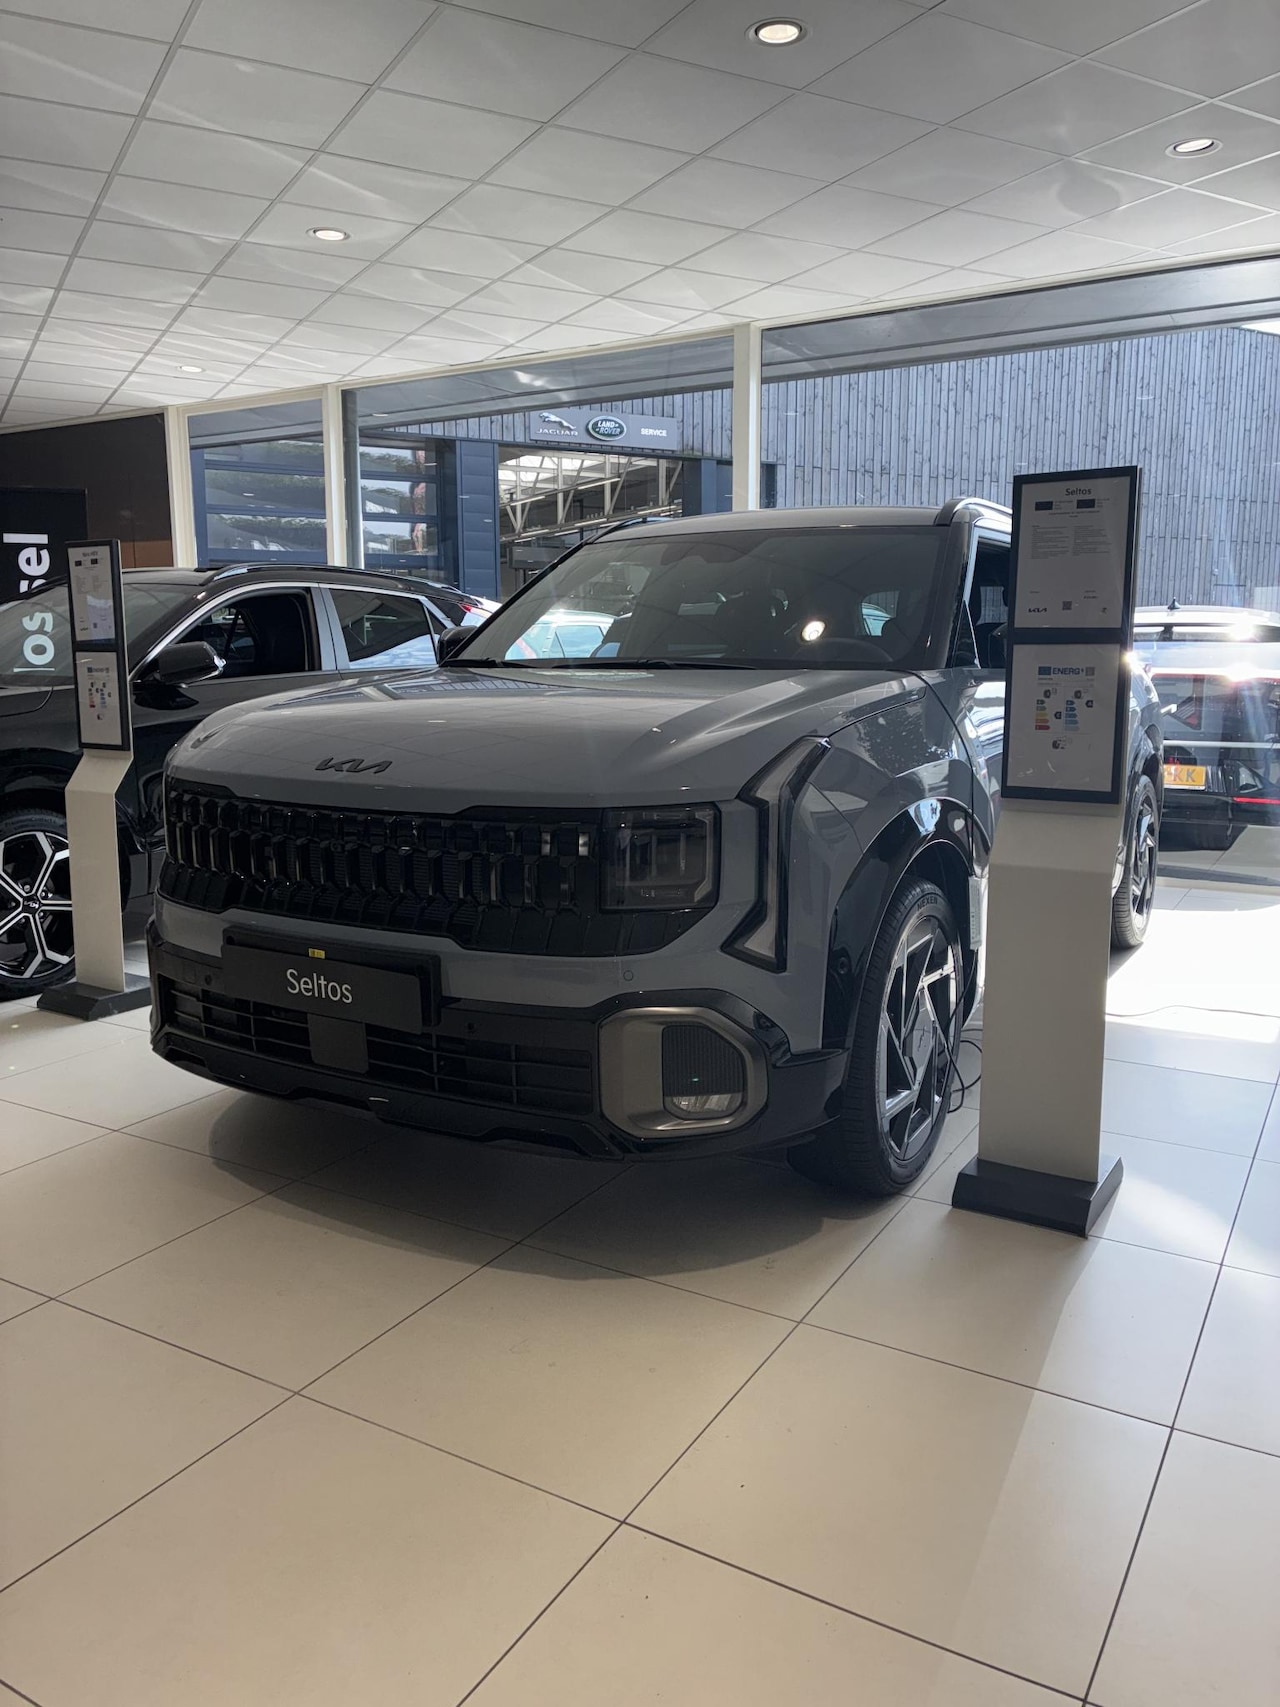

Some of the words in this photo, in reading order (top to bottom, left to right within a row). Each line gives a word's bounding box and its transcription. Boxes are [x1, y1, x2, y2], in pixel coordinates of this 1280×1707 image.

[597, 420, 615, 428] LAND
[536, 428, 579, 436] JAGUAR
[599, 427, 621, 435] ROVER
[640, 427, 668, 437] SERVICE
[1064, 487, 1092, 496] Seltos
[1052, 667, 1080, 675] ENERG
[314, 757, 393, 774] KIA
[917, 895, 938, 911] NEXEN
[286, 968, 353, 1003] Seltos
